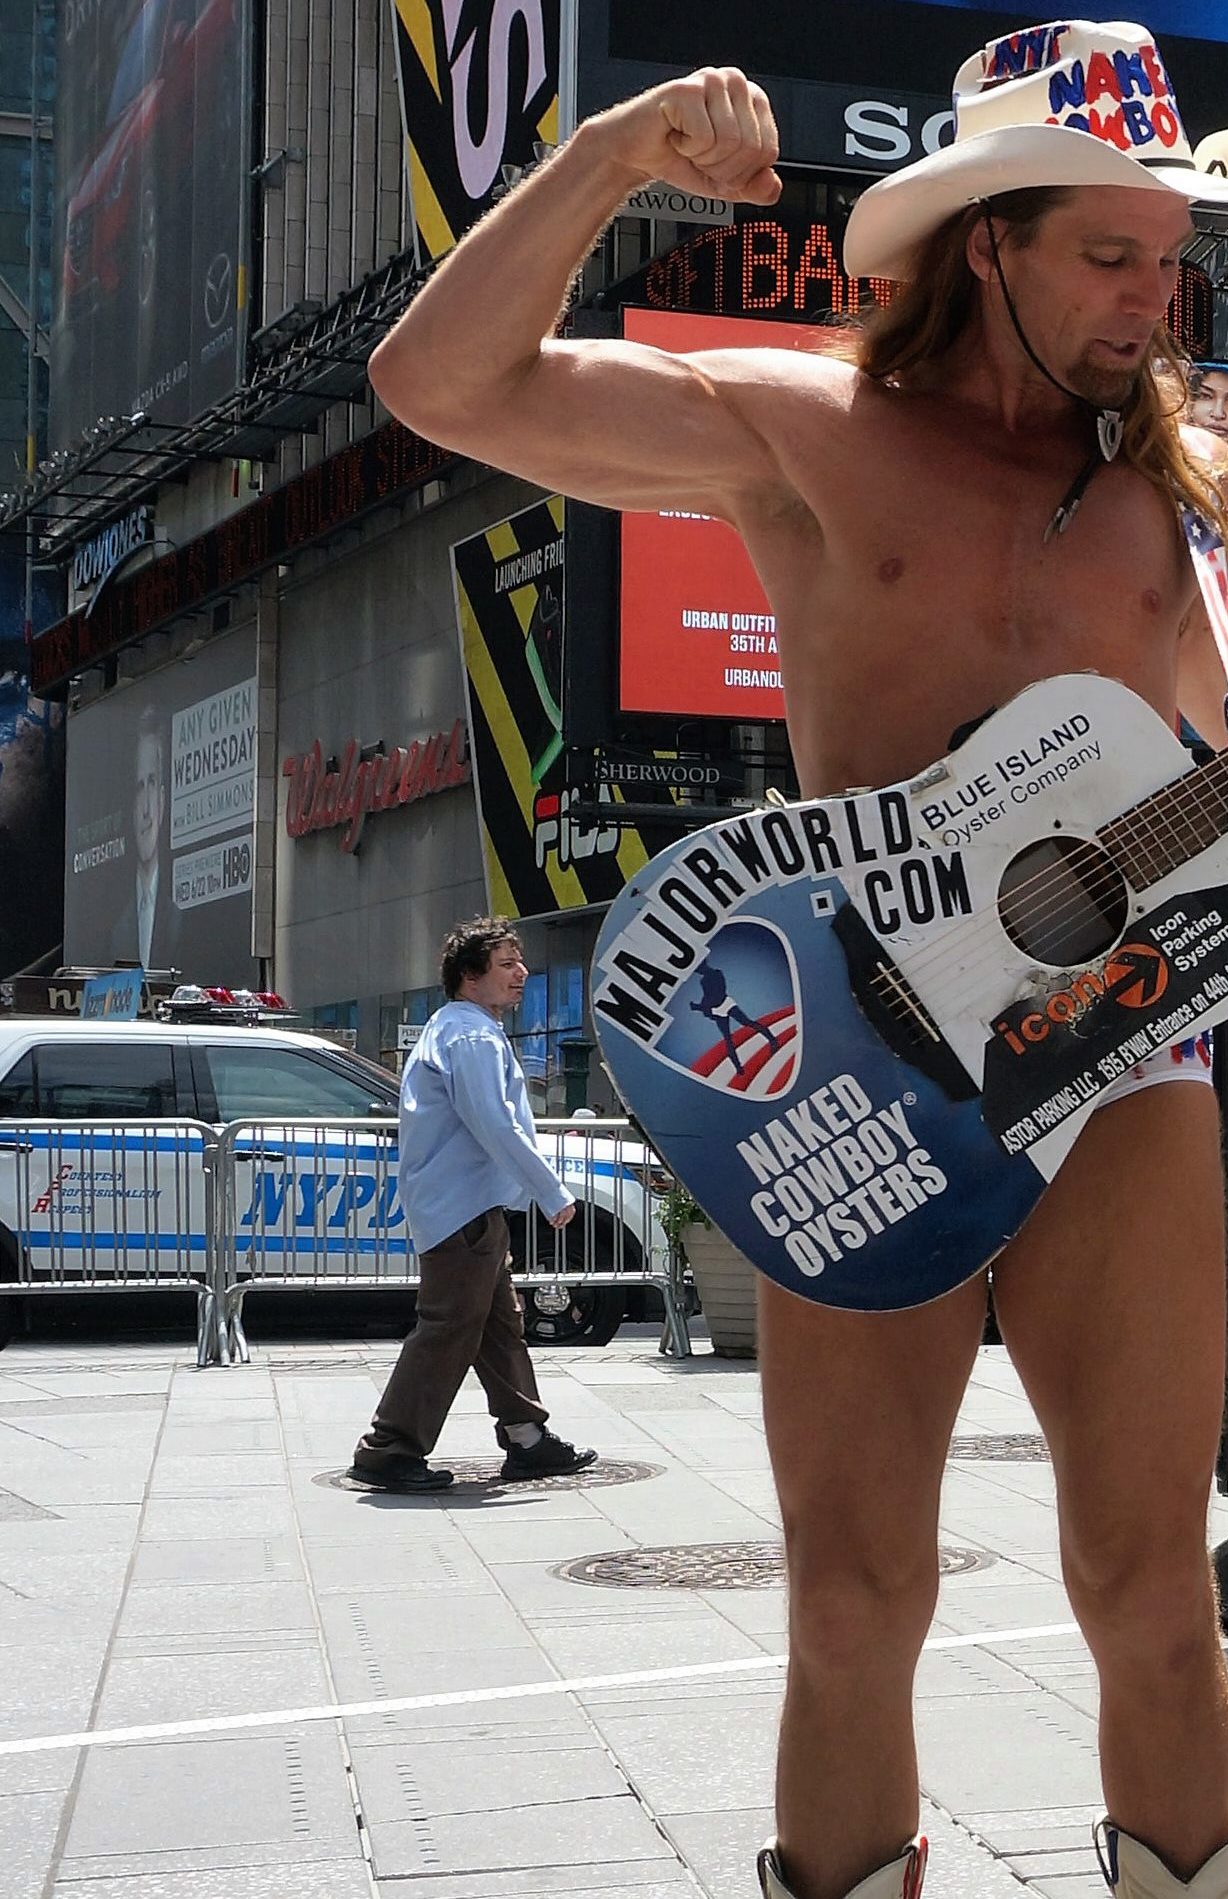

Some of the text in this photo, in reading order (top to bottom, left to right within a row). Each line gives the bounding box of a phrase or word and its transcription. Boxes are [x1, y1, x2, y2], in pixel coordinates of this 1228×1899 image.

[494, 553, 543, 594] LAUNCHING
[682, 608, 729, 630] URBAN
[730, 634, 765, 653] 35TH
[178, 686, 252, 748] ANY GIVEN
[174, 725, 256, 789] WEDNESDAY
[599, 758, 721, 784] SHERWOOD
[920, 714, 1091, 831] BLUE ISLAND
[186, 803, 205, 825] BILL
[942, 740, 1102, 847] Oyster Company
[222, 843, 251, 889] HBO
[864, 851, 974, 936] COM
[1150, 910, 1187, 942] Icon
[1161, 909, 1222, 958] Parking
[997, 970, 1106, 1056] icon
[1000, 1113, 1040, 1155] ASTOR
[1033, 1085, 1080, 1129] PARKING
[1074, 1071, 1101, 1101] LLC
[1096, 1048, 1124, 1082] 1515
[1150, 1003, 1196, 1043] Entrance
[1191, 994, 1210, 1019] on
[735, 1074, 873, 1185] NAKED
[784, 1148, 948, 1278] OYSTERS
